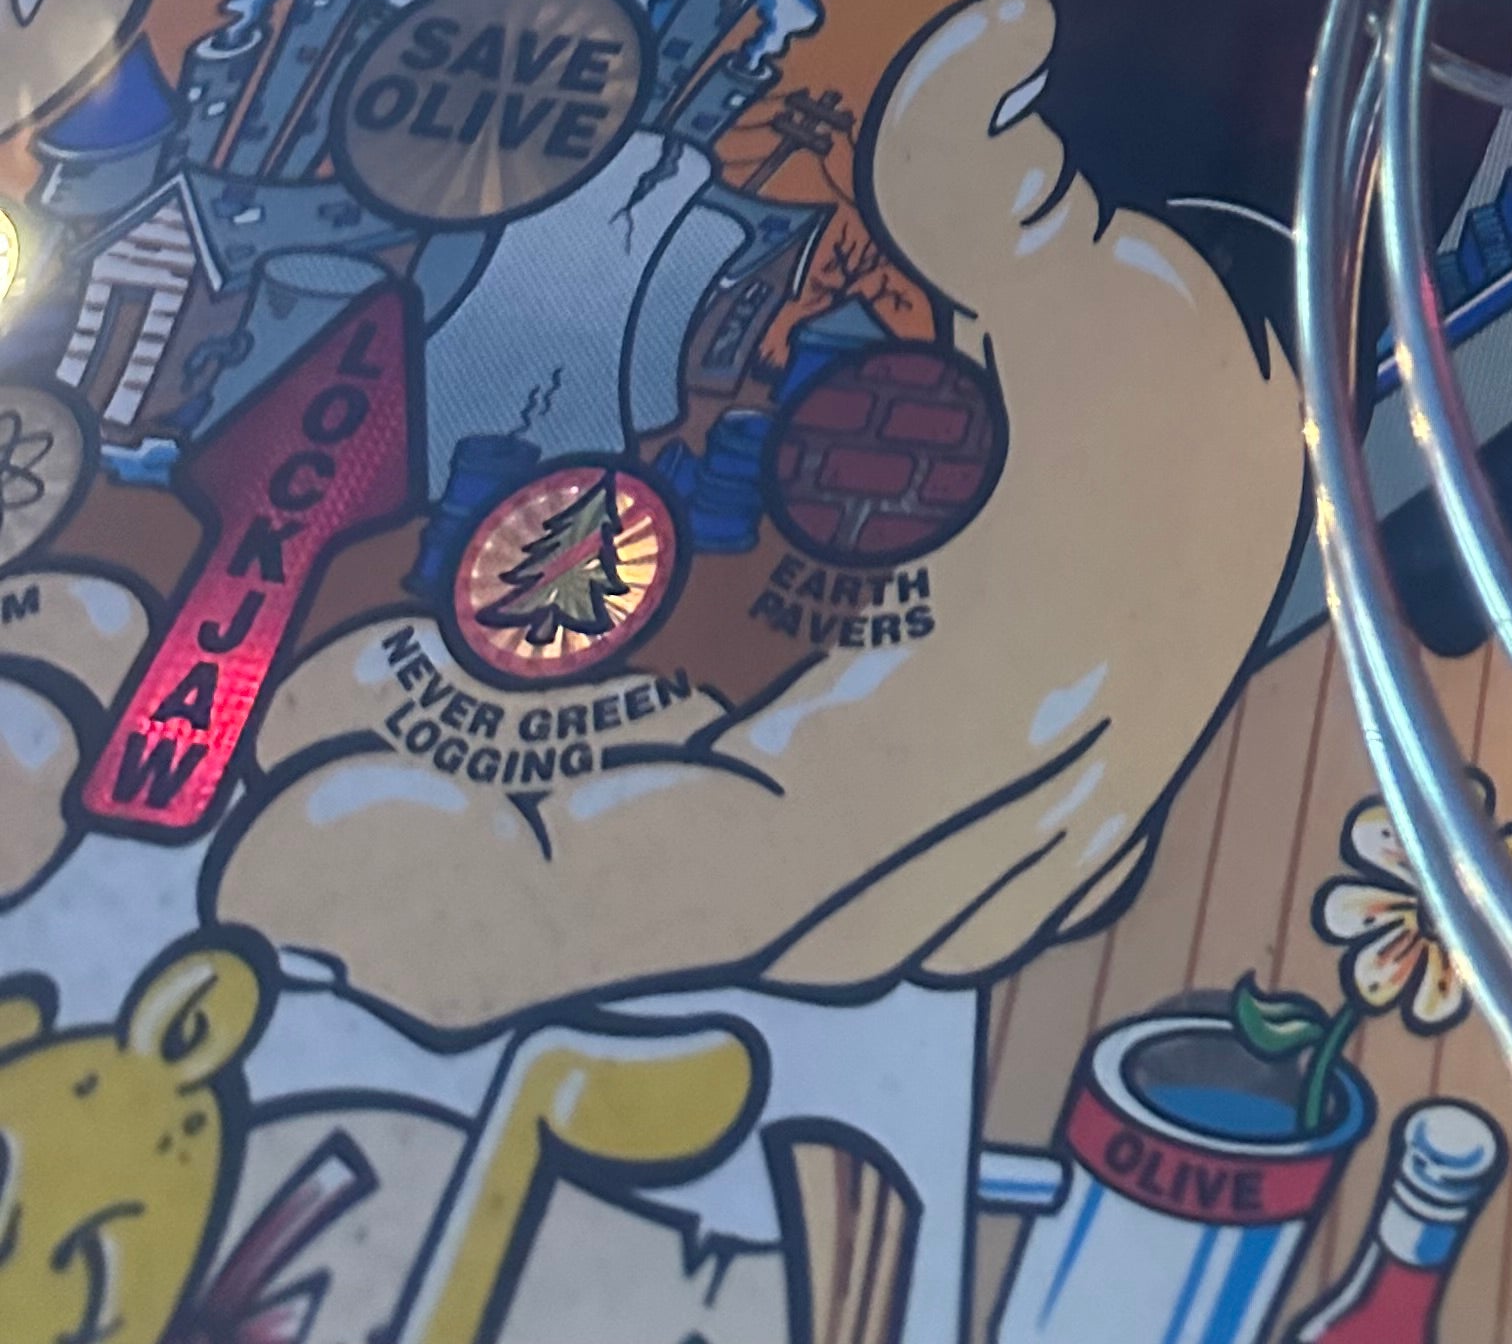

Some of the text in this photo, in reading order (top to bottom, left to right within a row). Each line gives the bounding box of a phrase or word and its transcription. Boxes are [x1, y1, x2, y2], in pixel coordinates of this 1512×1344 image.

[398, 16, 622, 95] SAVE
[355, 74, 618, 162] OLIVE
[769, 553, 931, 607] EARTH
[749, 605, 936, 649] PAVERS
[382, 624, 694, 741] NEVER GREEN
[384, 697, 596, 784] LOGGING
[1102, 1131, 1267, 1212] OLIVE
